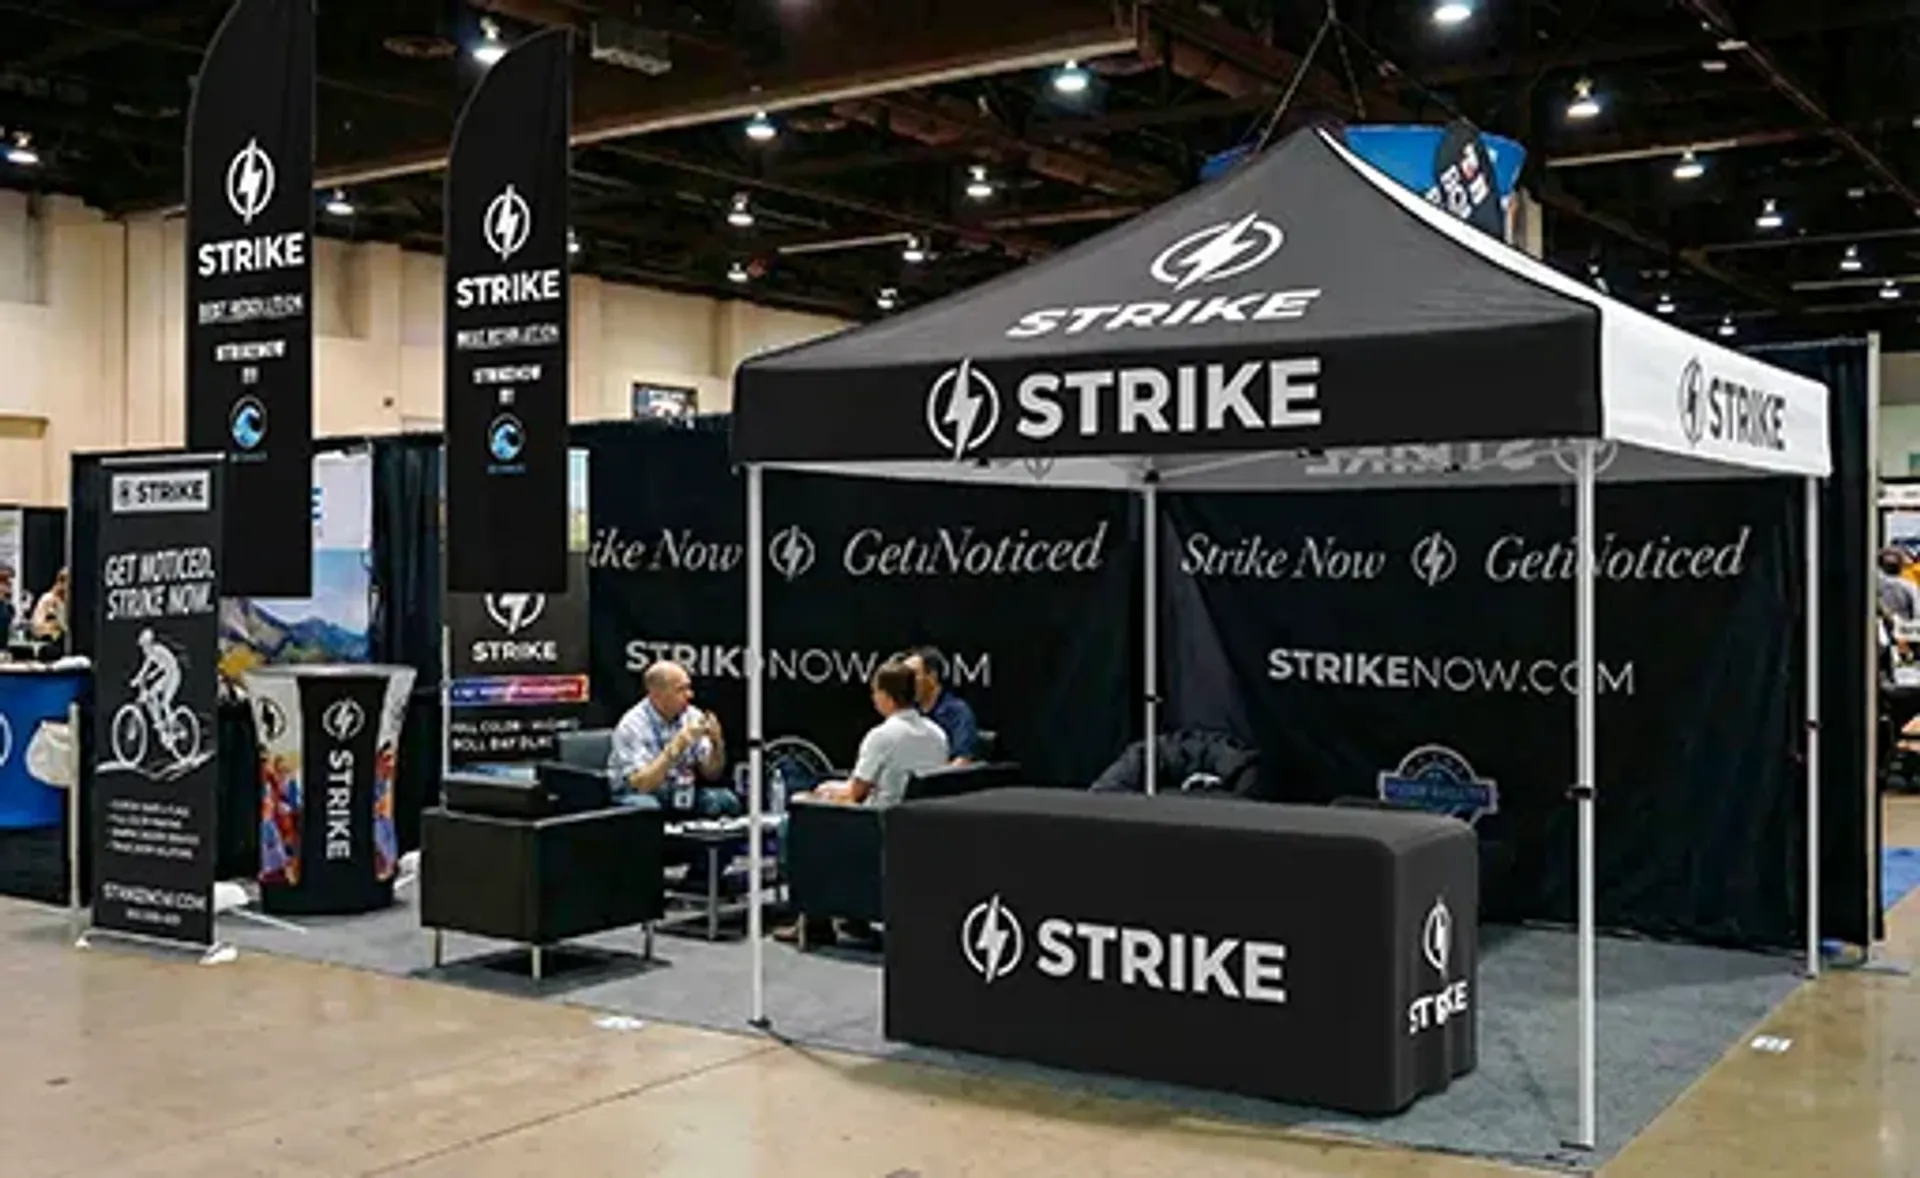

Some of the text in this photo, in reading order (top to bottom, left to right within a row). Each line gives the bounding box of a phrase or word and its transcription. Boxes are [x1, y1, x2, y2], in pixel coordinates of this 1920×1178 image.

[198, 232, 305, 276] STRIKE
[456, 268, 560, 308] STRIKE
[1004, 288, 1322, 337] STRIKE
[1016, 358, 1322, 438] STRIKE
[1710, 374, 1786, 452] STRIKE
[137, 479, 204, 504] STRIKE
[105, 554, 137, 587] GET
[588, 527, 744, 572] ike Now
[1180, 532, 1387, 579] Strike Now
[471, 640, 558, 663] STRIKE
[625, 640, 992, 688] STRIKNOWM
[1267, 648, 1636, 696] STRIKENOW.COM
[326, 749, 355, 860] STRIKE
[1036, 918, 1288, 1003] STRIKE
